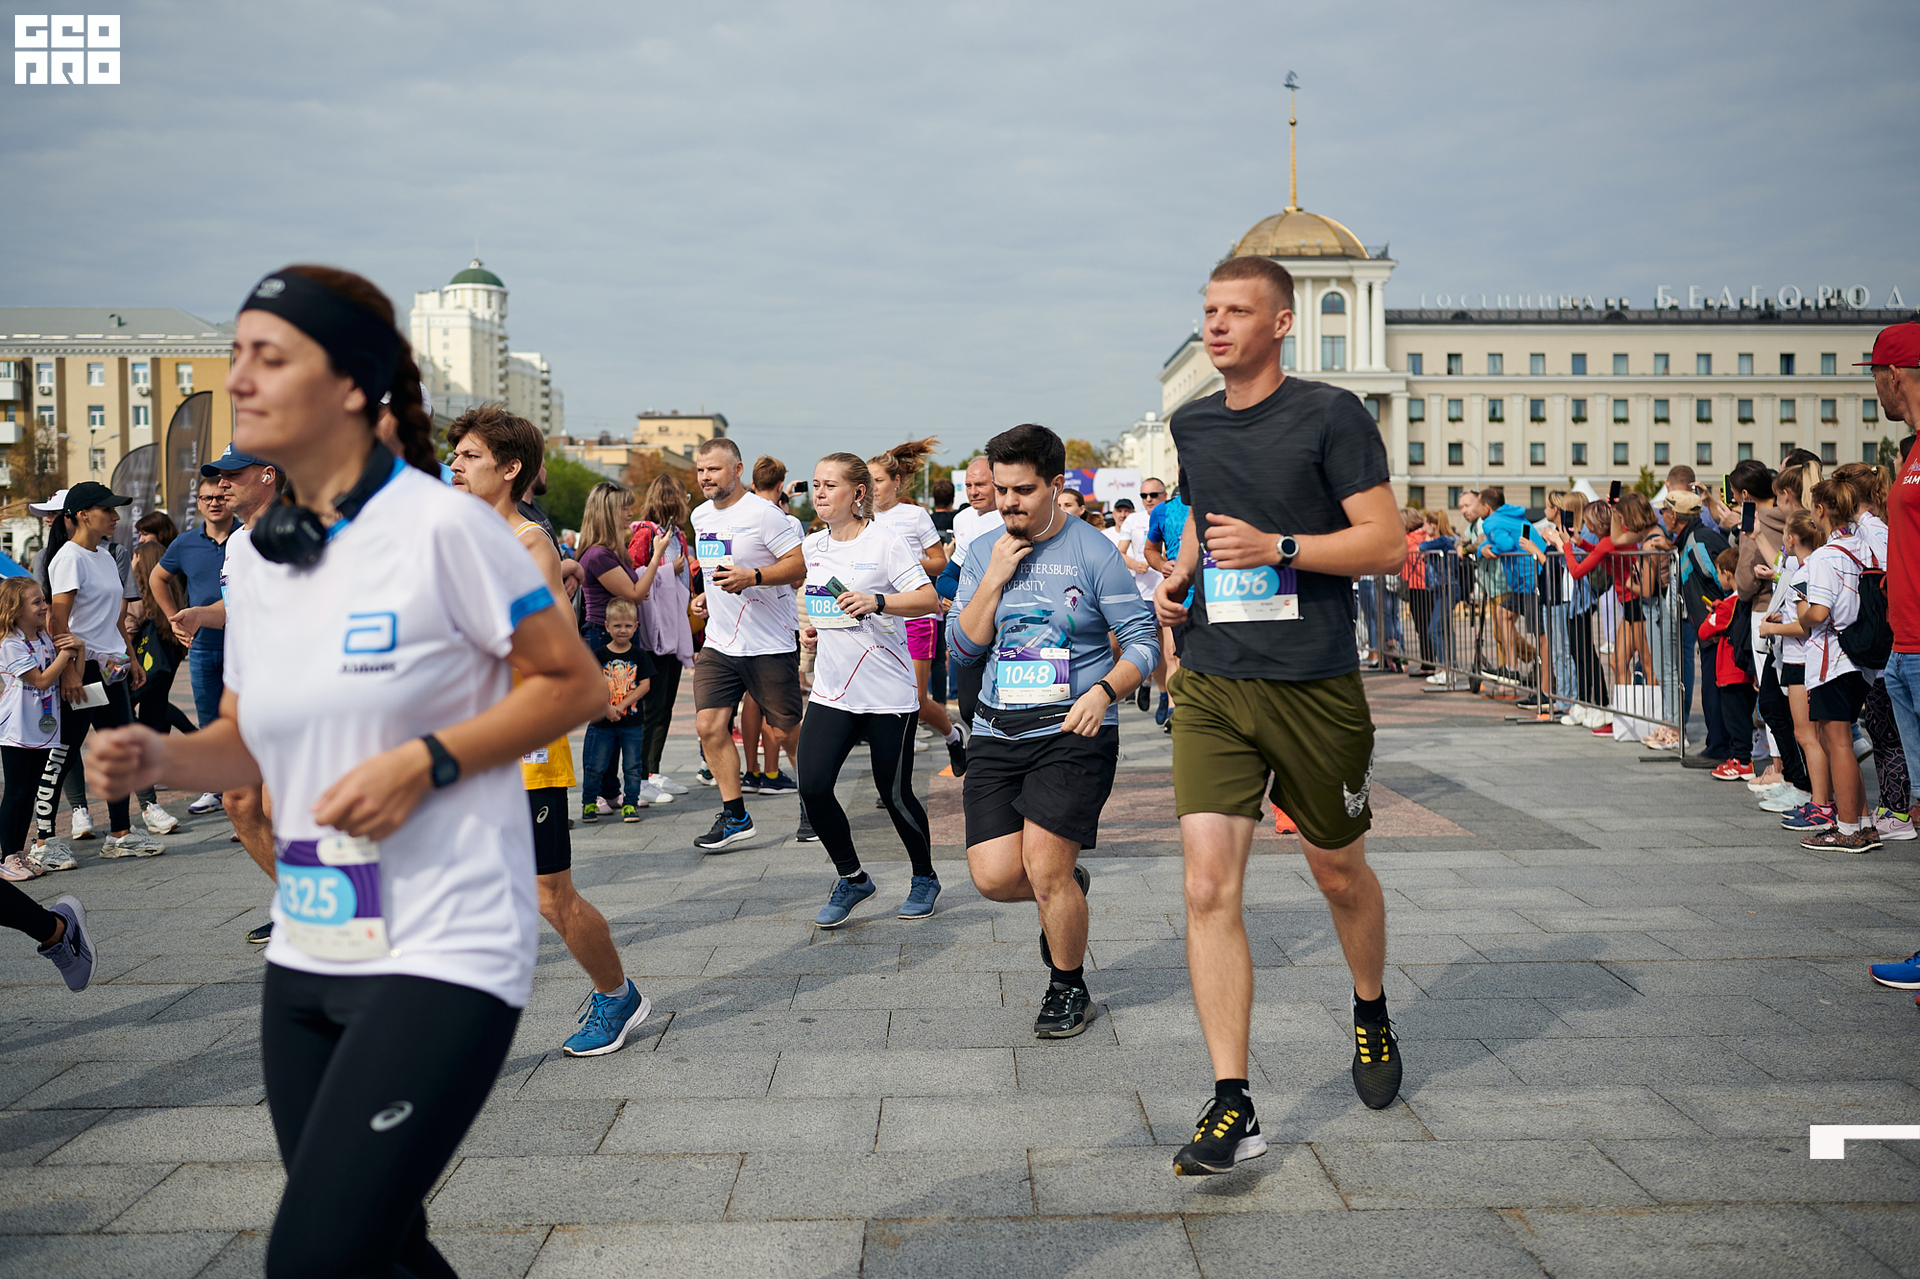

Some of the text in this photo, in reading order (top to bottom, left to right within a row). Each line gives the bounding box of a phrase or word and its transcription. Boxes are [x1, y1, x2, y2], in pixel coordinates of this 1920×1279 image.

[1655, 283, 1907, 310] БЕЛГОРОД
[701, 543, 719, 555] 1172
[1020, 563, 1078, 577] PETERSBURG
[1214, 571, 1268, 597] 1056
[810, 599, 841, 614] 1086
[1005, 665, 1050, 685] 1048
[36, 786, 54, 816] DO
